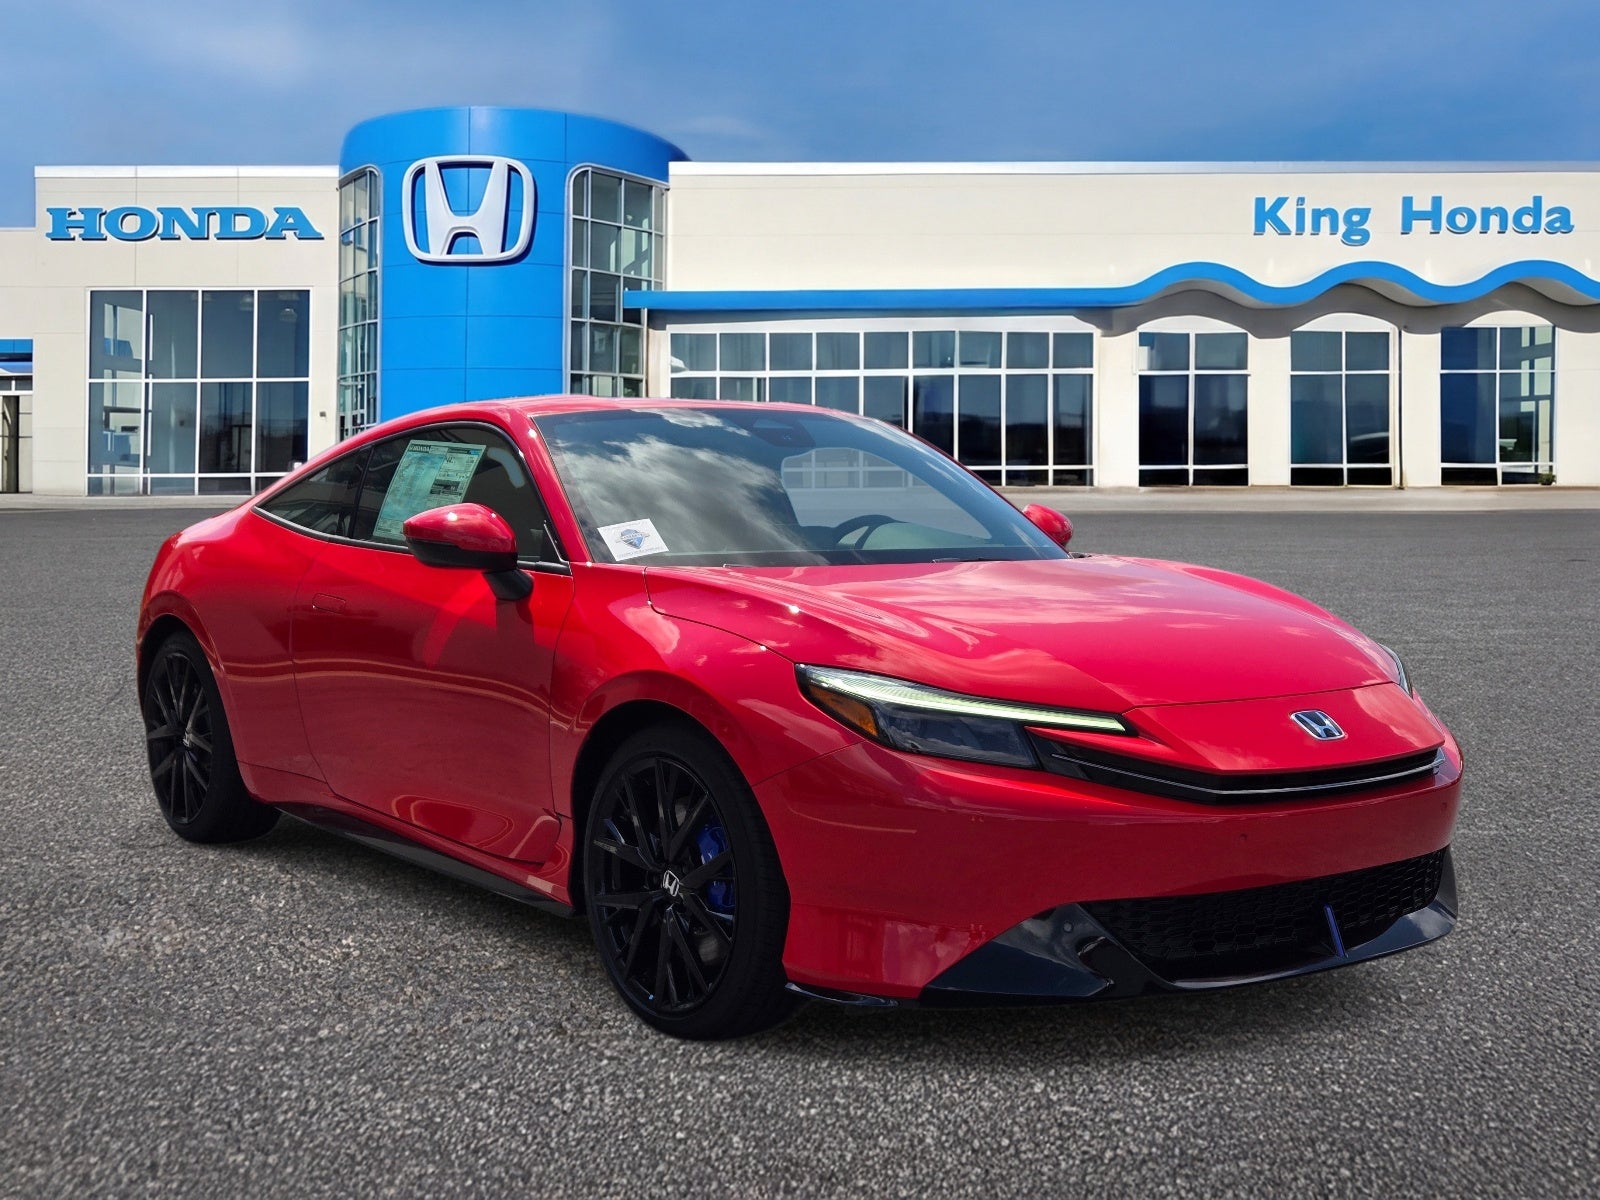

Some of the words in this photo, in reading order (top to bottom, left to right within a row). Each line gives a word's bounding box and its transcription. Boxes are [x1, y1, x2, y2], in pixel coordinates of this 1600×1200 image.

[45, 206, 325, 241] HONDA
[1253, 197, 1373, 246] King
[1401, 195, 1575, 235] Honda
